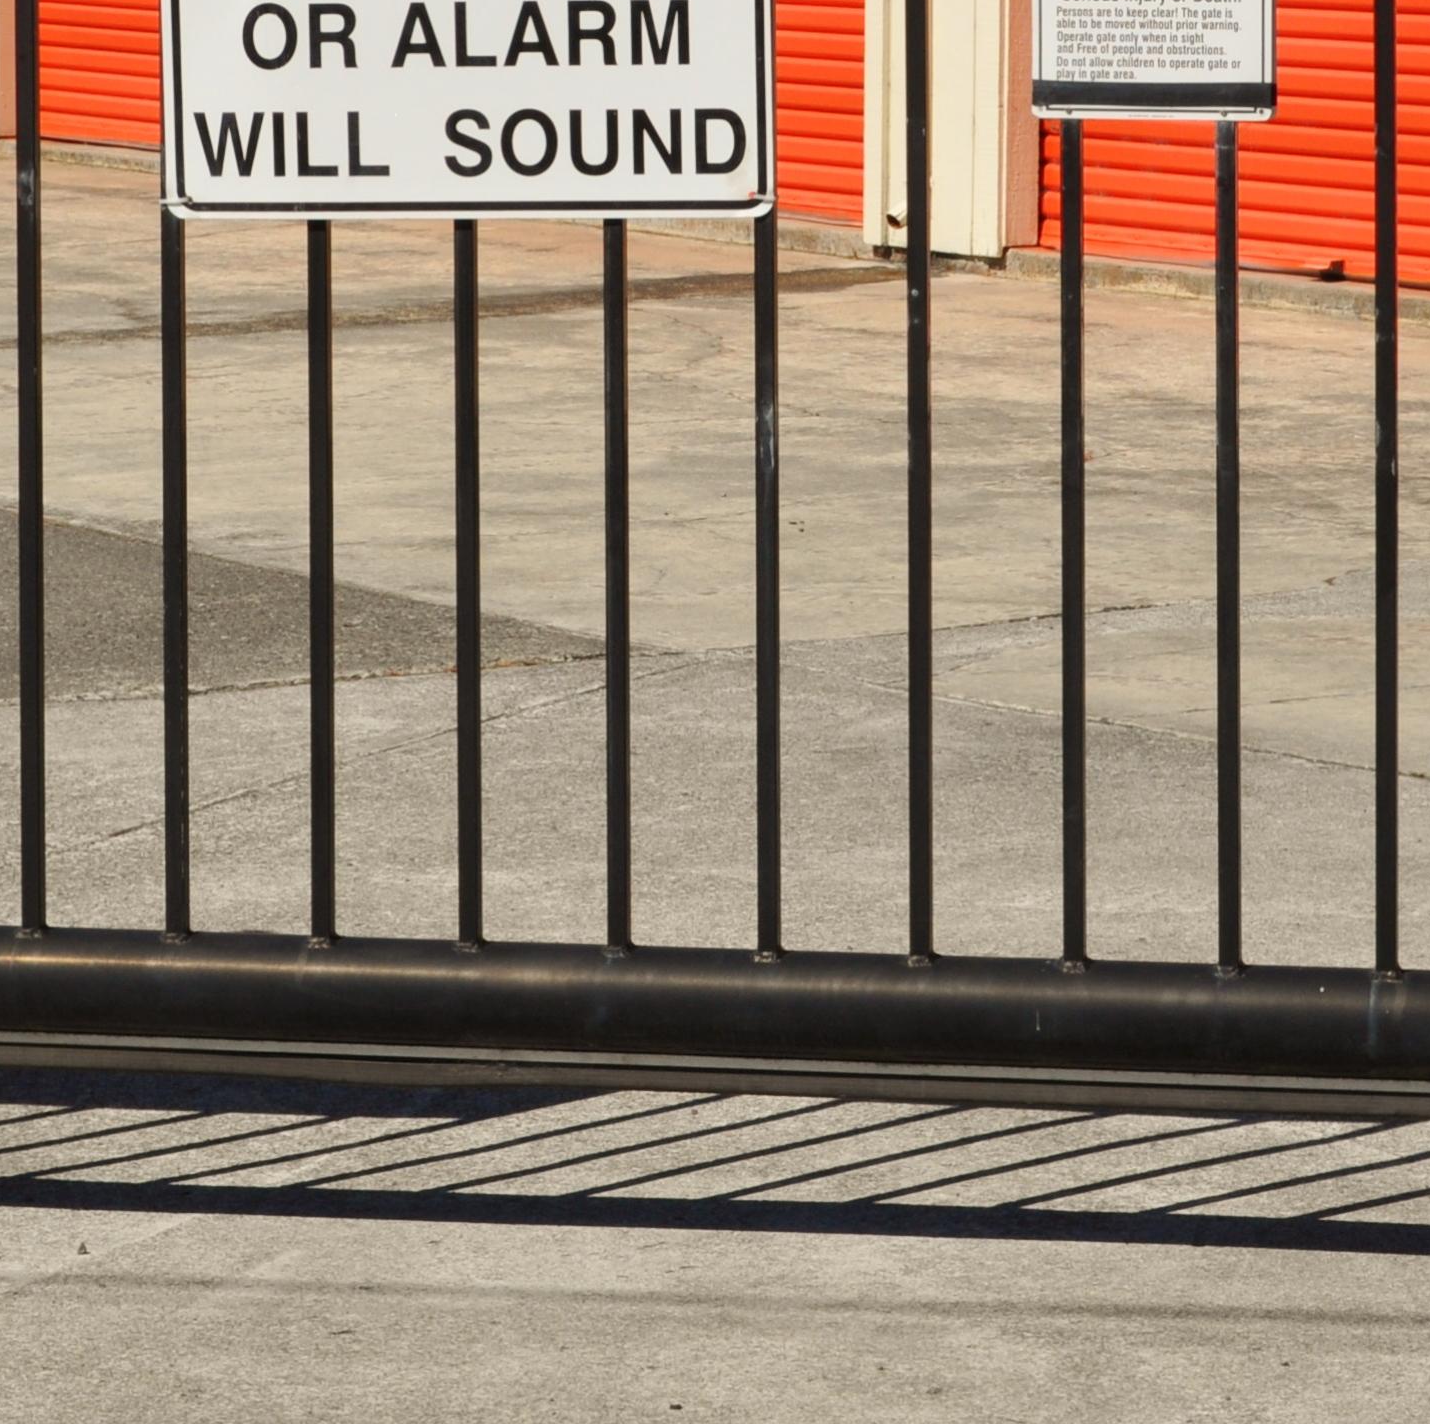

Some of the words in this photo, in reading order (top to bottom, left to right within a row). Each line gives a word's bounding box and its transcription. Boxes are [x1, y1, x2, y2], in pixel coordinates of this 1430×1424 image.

[1057, 6, 1093, 17] Persons
[1097, 8, 1111, 17] are
[1115, 8, 1123, 17] to
[1127, 8, 1148, 19] keep
[1151, 8, 1178, 18] clear!
[1182, 8, 1198, 18] The
[1202, 8, 1221, 20] gate
[1225, 8, 1233, 18] is
[1057, 19, 1076, 28] able
[1079, 19, 1088, 28] to
[1091, 20, 1102, 29] be
[1105, 20, 1136, 29] moved
[1139, 20, 1173, 29] without
[1176, 20, 1197, 31] prior
[1201, 21, 1242, 32] warning.
[243, 3, 357, 70] OR
[392, 0, 690, 67] ALARM
[1057, 32, 1093, 43] Operate
[1096, 33, 1116, 44] gate
[1119, 33, 1138, 43] only
[1142, 33, 1166, 42] when
[1170, 33, 1177, 43] in
[1181, 34, 1203, 45] sight
[1057, 44, 1073, 53] and
[1077, 44, 1097, 53] Free
[1100, 44, 1109, 53] of
[1113, 44, 1143, 55] people
[1146, 45, 1163, 54] and
[1166, 45, 1227, 55] obstructions.
[1057, 57, 1068, 66] Do
[1072, 57, 1086, 67] not
[1089, 57, 1113, 67] allow
[1117, 58, 1154, 68] children
[1158, 58, 1166, 68] to
[1170, 59, 1204, 69] operate
[1208, 59, 1228, 70] gate
[1057, 69, 1075, 81] play
[1079, 69, 1087, 79] in
[1090, 69, 1110, 81] gate
[1113, 71, 1137, 79] area.
[194, 112, 390, 177] WILL
[445, 109, 746, 177] SOUND
